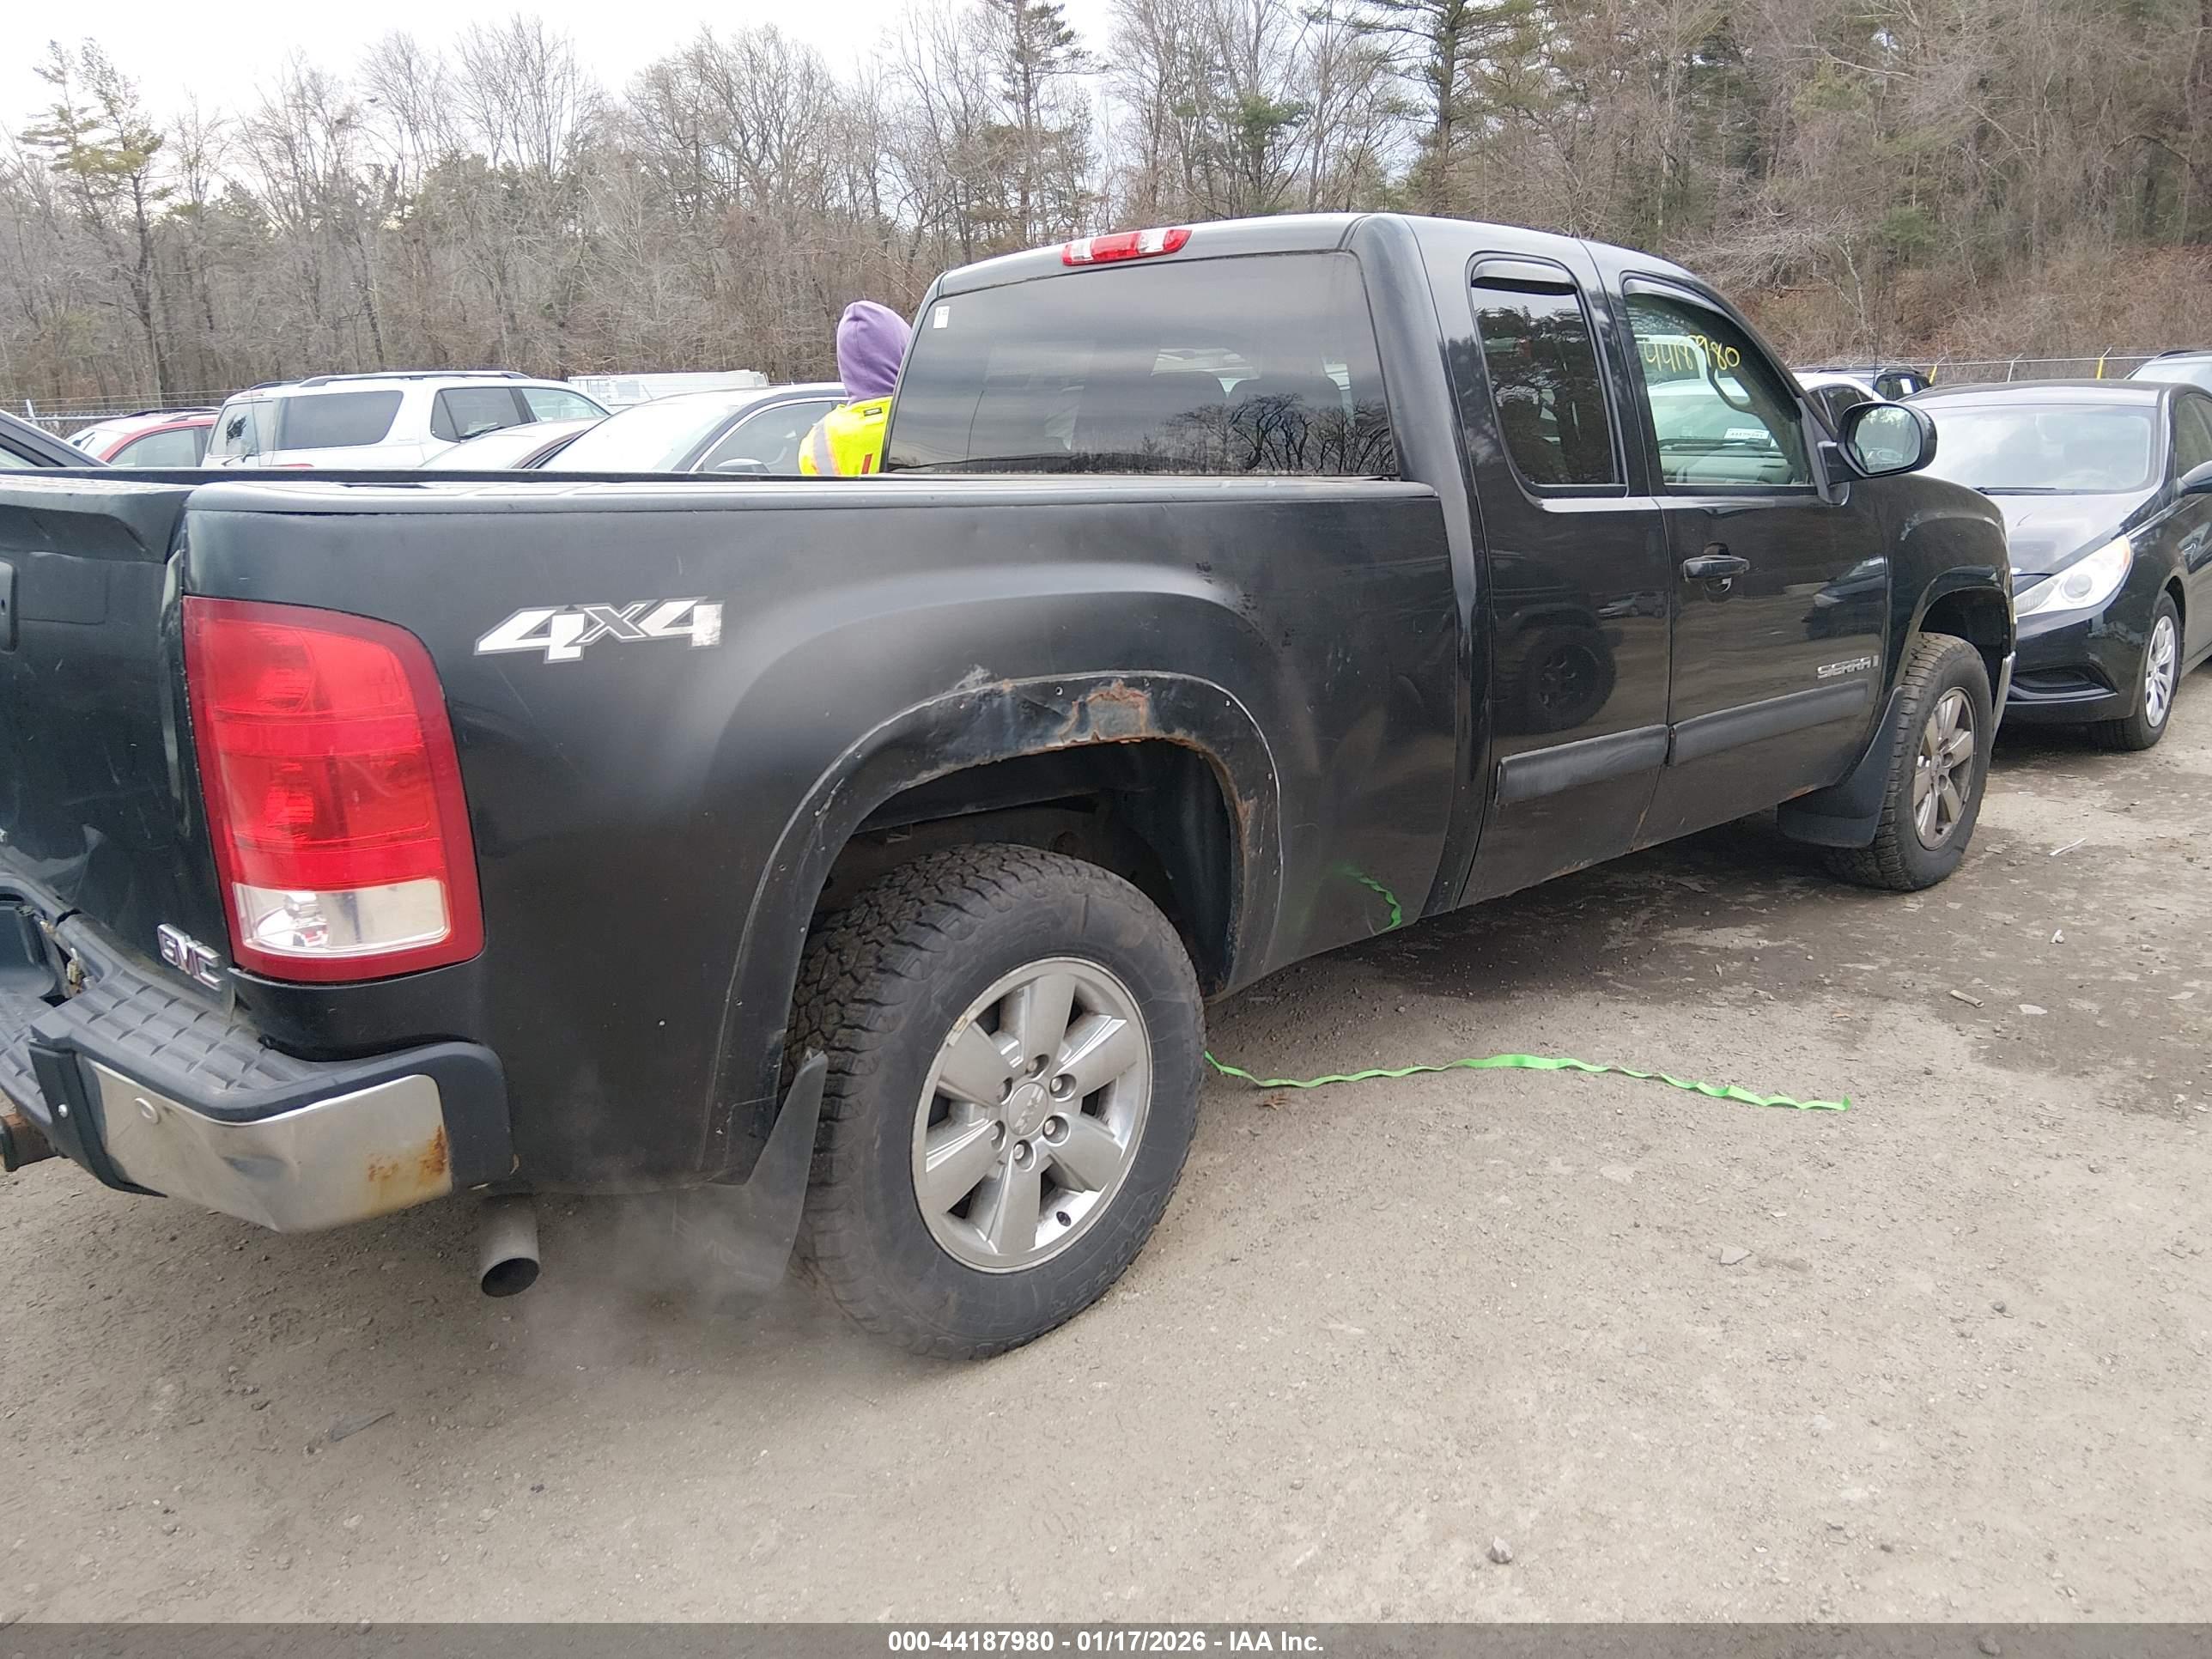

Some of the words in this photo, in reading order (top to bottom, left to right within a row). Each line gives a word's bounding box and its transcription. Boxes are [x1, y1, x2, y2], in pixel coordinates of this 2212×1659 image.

[1641, 334, 1741, 373] 4418980
[1817, 656, 1872, 681] SIERRA
[157, 923, 222, 992] GMC
